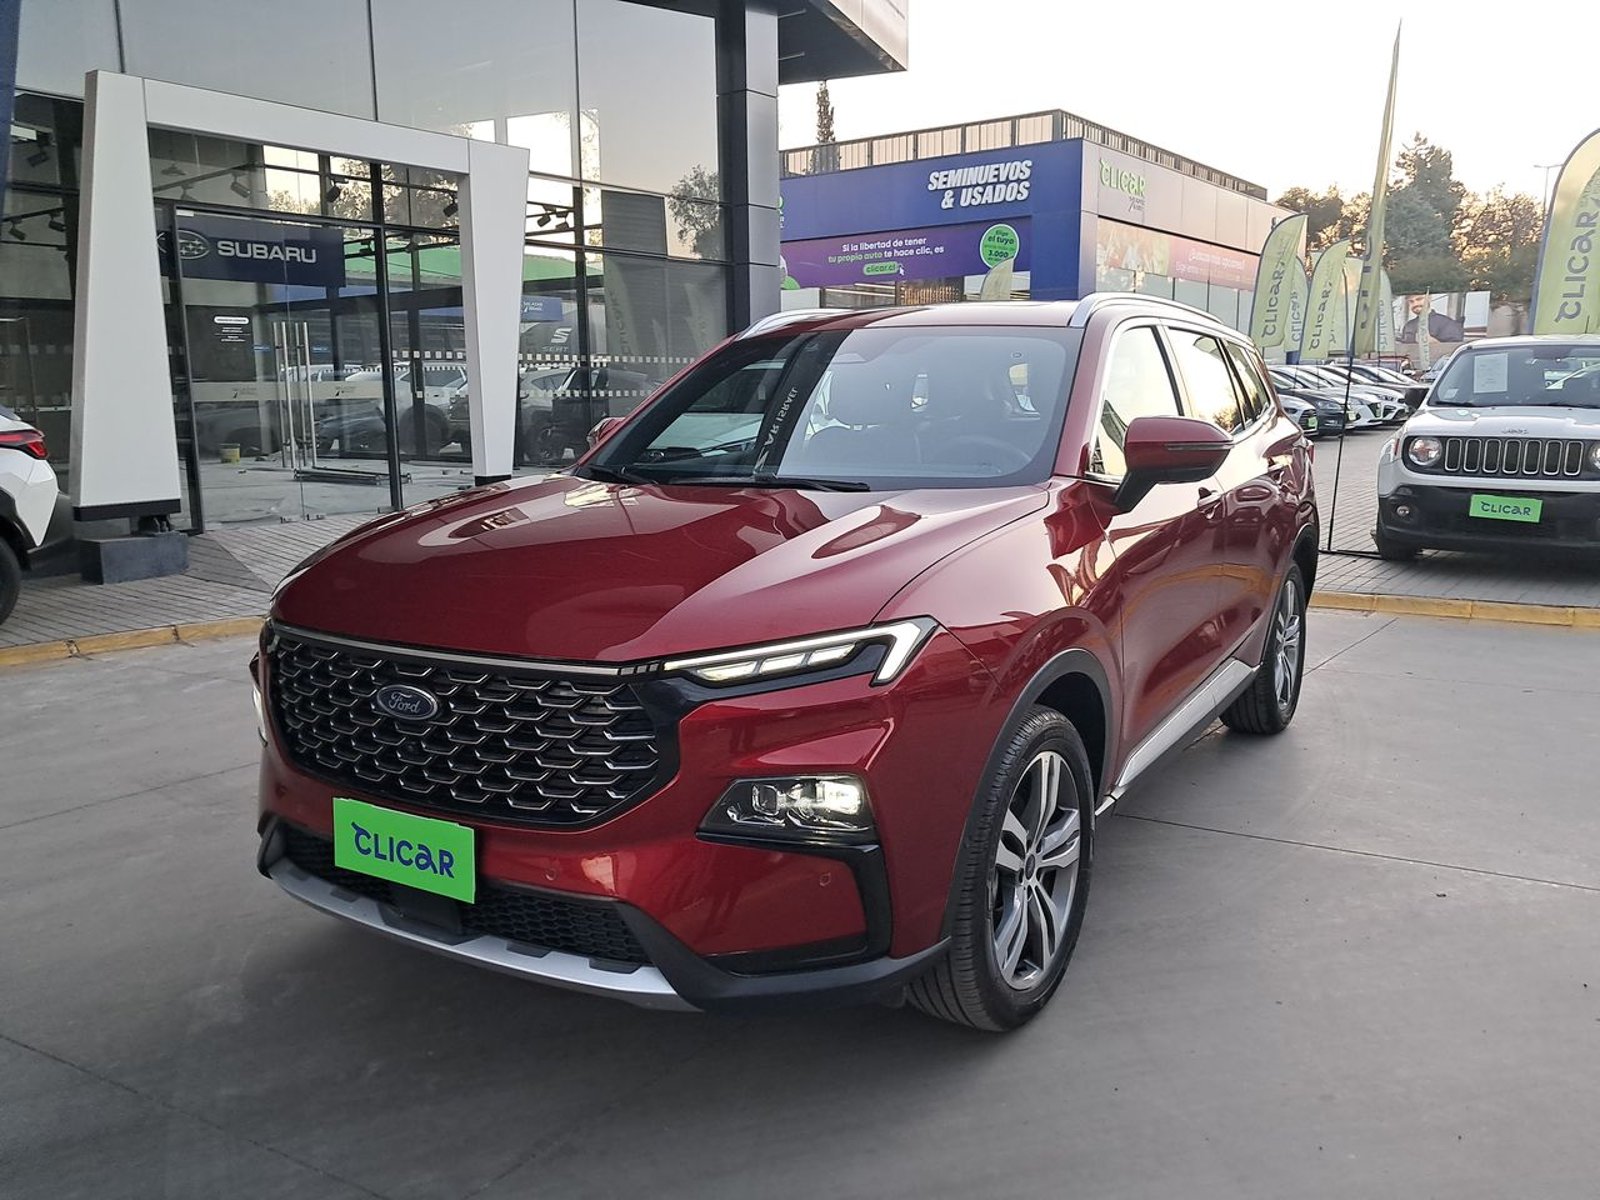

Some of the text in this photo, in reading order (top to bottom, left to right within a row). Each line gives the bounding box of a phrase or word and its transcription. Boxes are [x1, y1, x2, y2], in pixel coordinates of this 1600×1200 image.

[927, 159, 1033, 191] SEMINUEVOS
[940, 181, 1031, 210] & USADOS
[217, 240, 317, 264] SUBARU
[828, 255, 837, 263] tu
[837, 253, 863, 264] propio
[864, 251, 883, 260] auto
[884, 250, 892, 258] te
[893, 248, 915, 257] hace
[934, 245, 945, 253] es
[842, 238, 927, 252] Si la libertad de tener
[865, 263, 896, 273] clicar.cl
[389, 691, 421, 713] Ford
